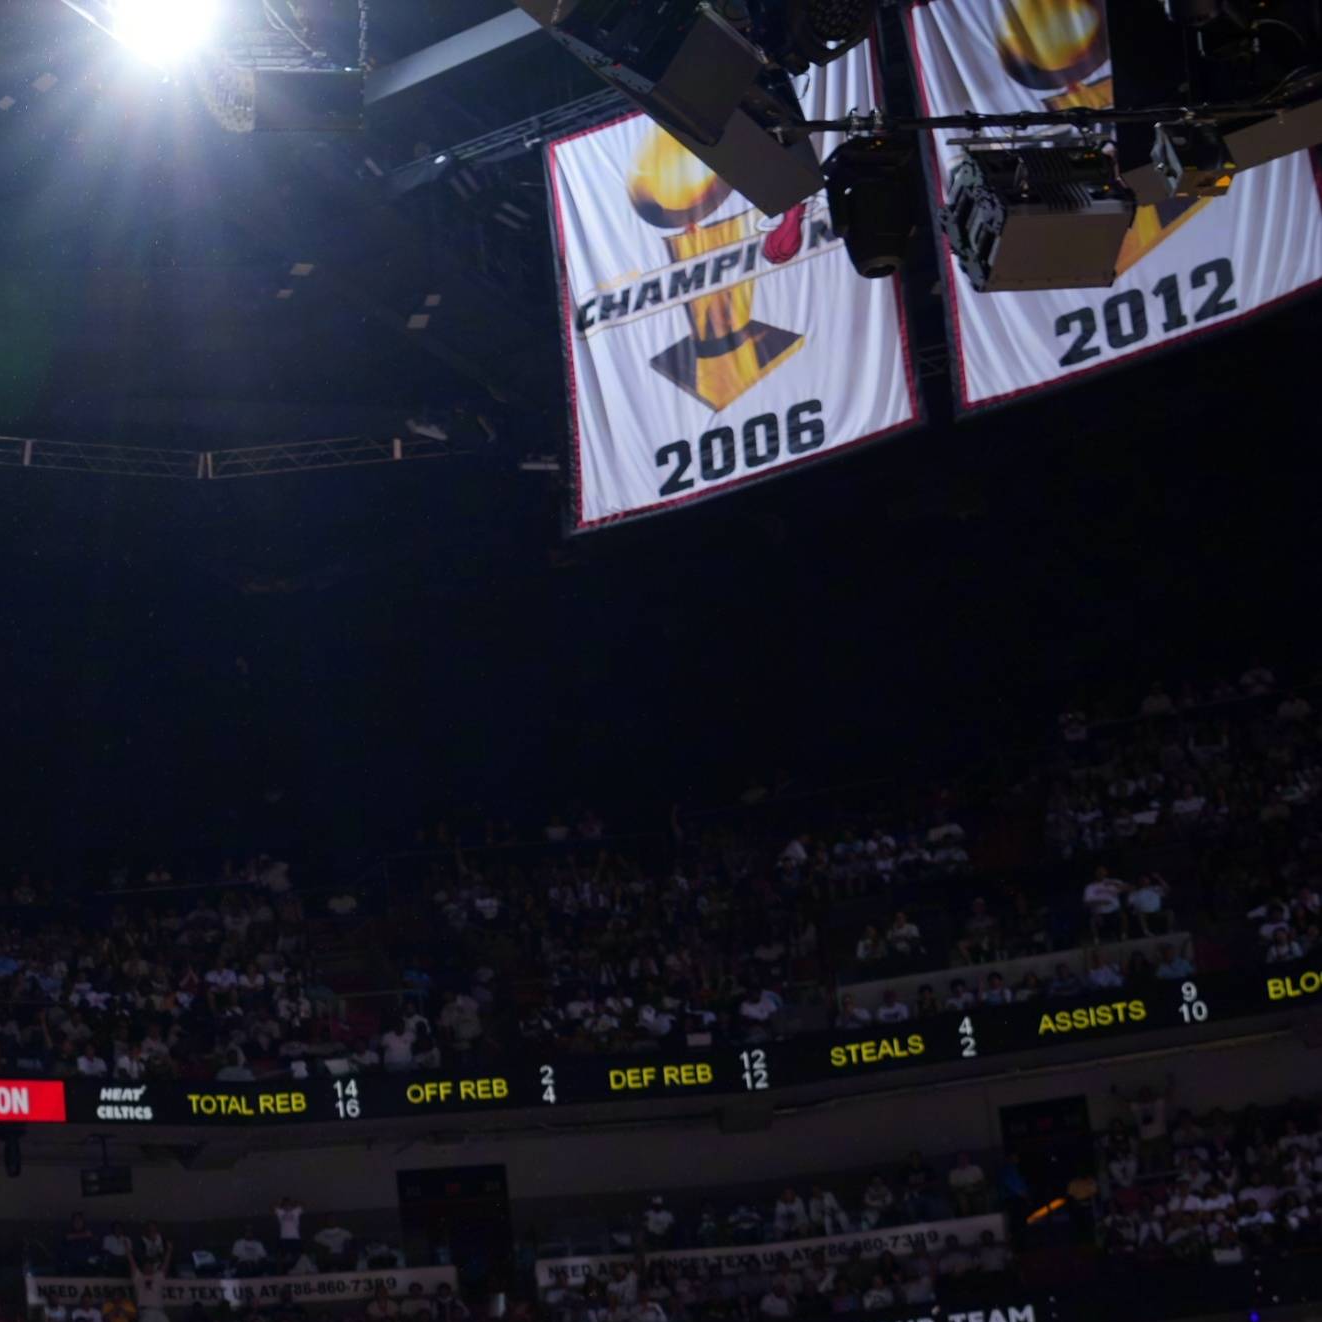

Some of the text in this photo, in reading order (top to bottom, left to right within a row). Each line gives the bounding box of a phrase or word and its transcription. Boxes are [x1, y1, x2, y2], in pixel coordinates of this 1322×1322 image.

[1054, 256, 1237, 368] 2012
[655, 399, 824, 497] 2006
[1181, 981, 1198, 1002] 9
[1038, 1000, 1147, 1036] ASSISTS
[1178, 1001, 1208, 1024] 10
[958, 1016, 973, 1036] 4
[830, 1034, 925, 1068] STEALS
[960, 1037, 976, 1058] 2
[739, 1050, 767, 1070] 12
[539, 1065, 554, 1085] 2
[609, 1064, 713, 1090] DEF REB
[741, 1070, 769, 1090] 12
[100, 1086, 145, 1103] HEAT
[333, 1079, 358, 1099] 14
[406, 1078, 508, 1104] OFF REB
[541, 1085, 556, 1104] 4
[96, 1103, 153, 1121] CELTICS
[188, 1091, 306, 1115] TOTAL REB
[334, 1099, 360, 1119] 16
